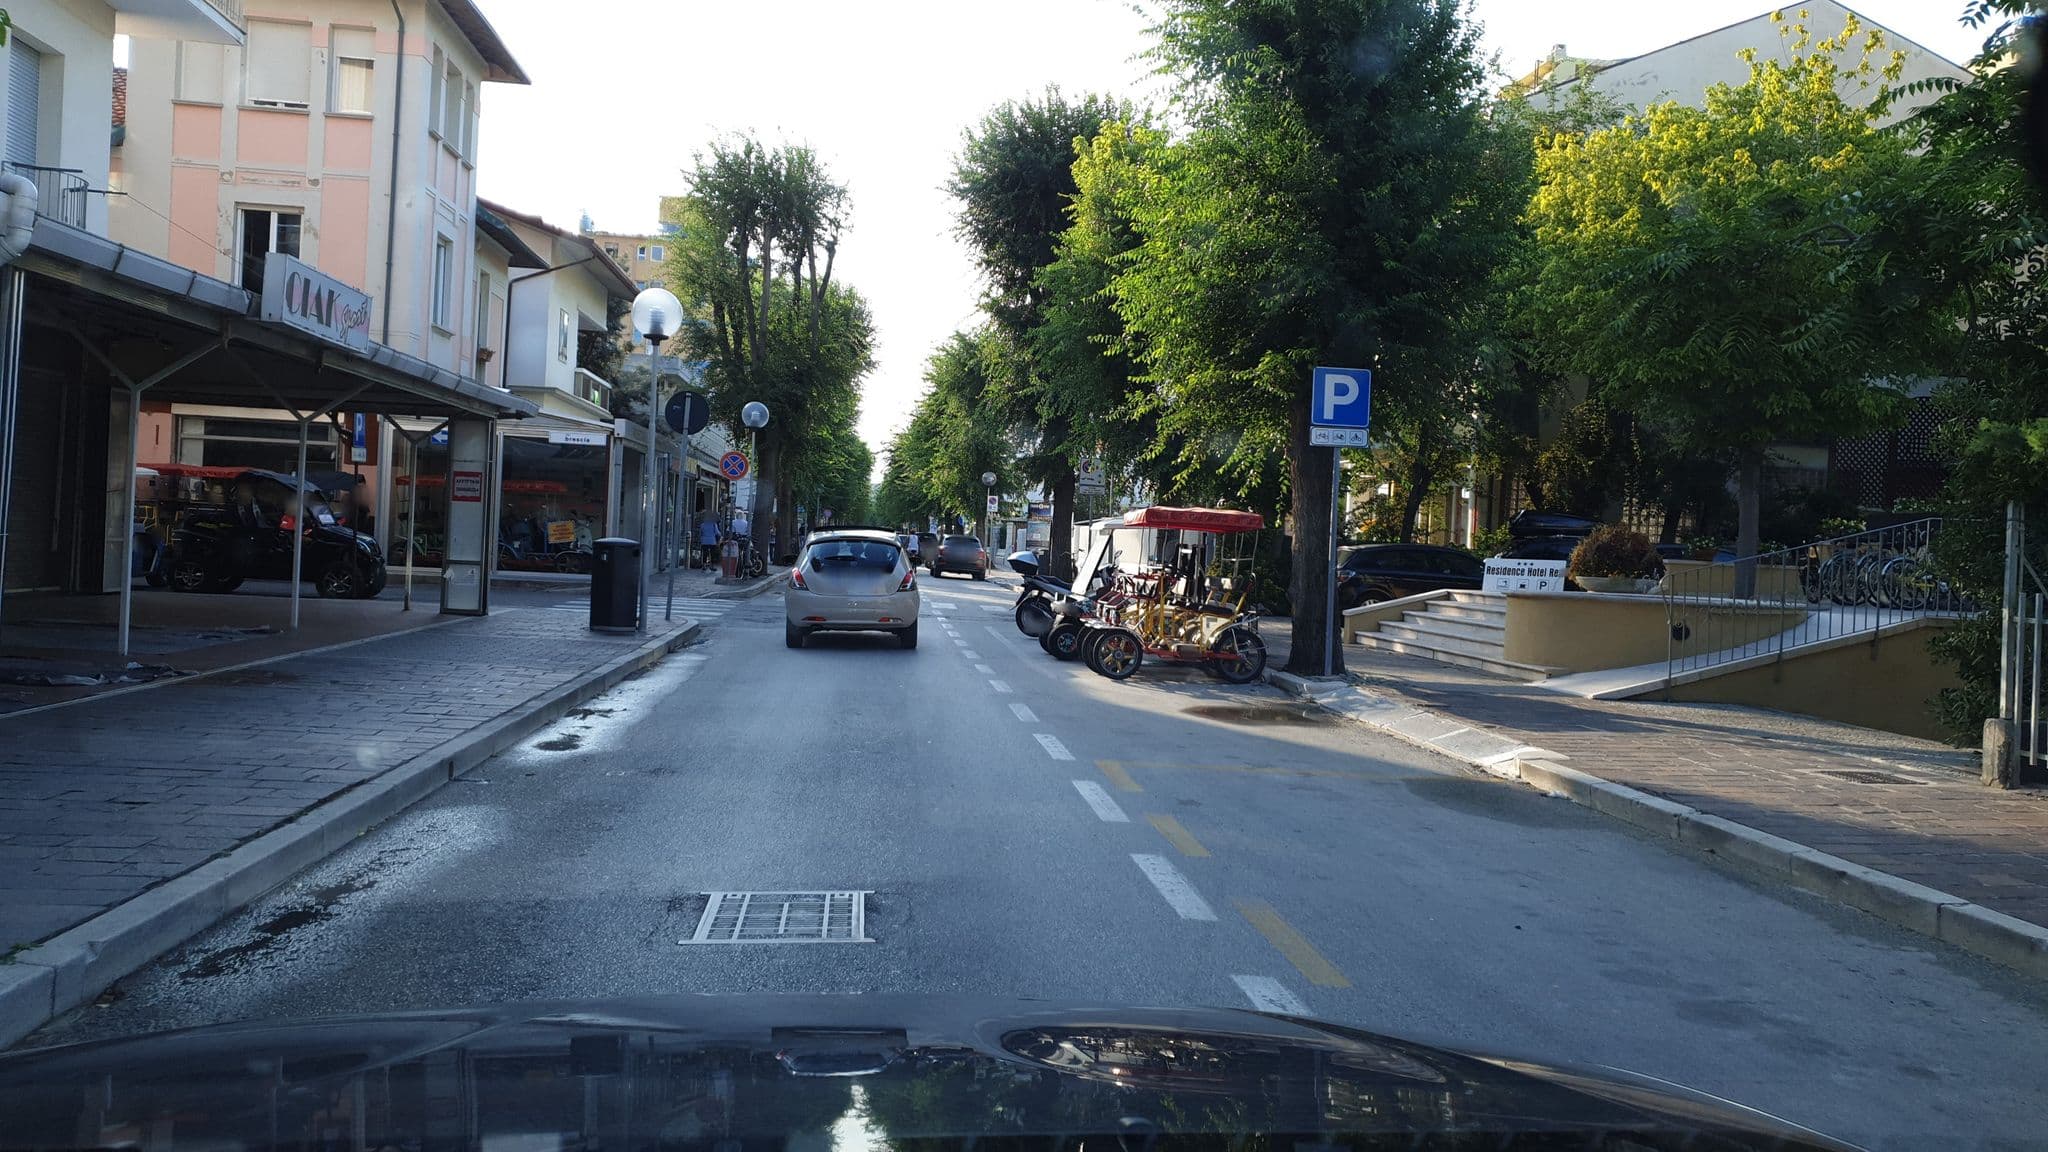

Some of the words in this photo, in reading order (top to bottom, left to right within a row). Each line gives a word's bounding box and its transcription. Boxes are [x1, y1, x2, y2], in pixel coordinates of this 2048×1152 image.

[286, 272, 341, 332] CIAK
[1323, 373, 1359, 420] P
[355, 413, 363, 441] P
[1486, 565, 1525, 577] Residence
[1527, 566, 1547, 577] Hotel
[1539, 581, 1547, 591] P
